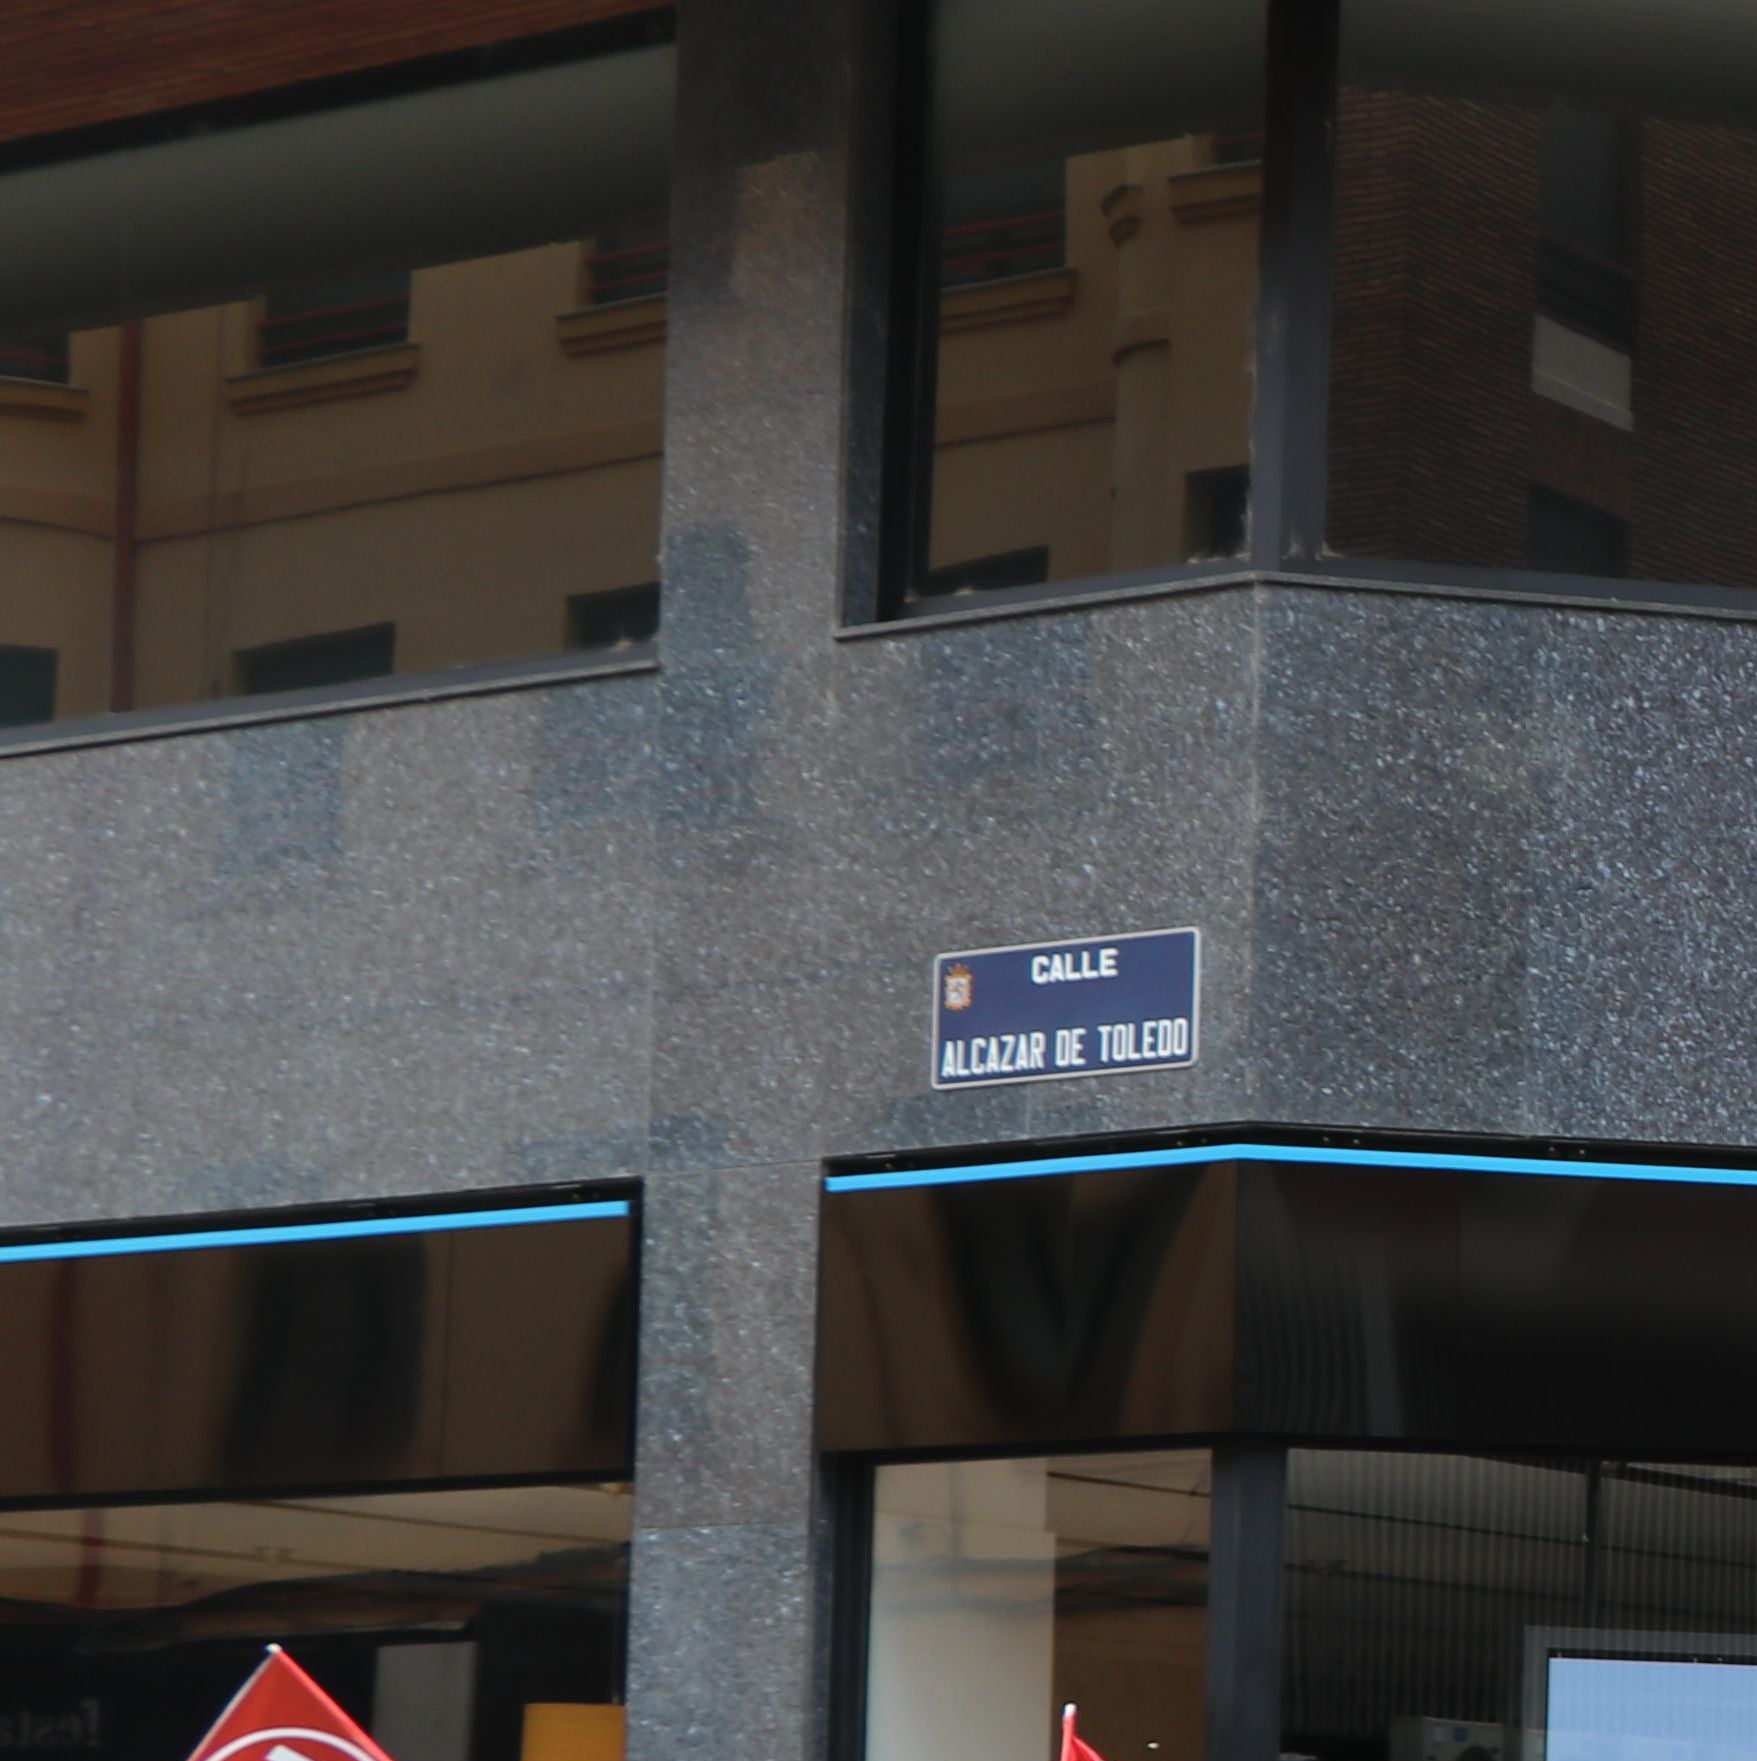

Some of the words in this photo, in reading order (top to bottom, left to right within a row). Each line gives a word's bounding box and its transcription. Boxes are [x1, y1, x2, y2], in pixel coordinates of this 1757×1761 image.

[1031, 948, 1119, 985] CALLE
[941, 1032, 1046, 1078] ALCAZAR
[1054, 1027, 1087, 1068] DE
[1097, 1017, 1189, 1063] TOLEDO
